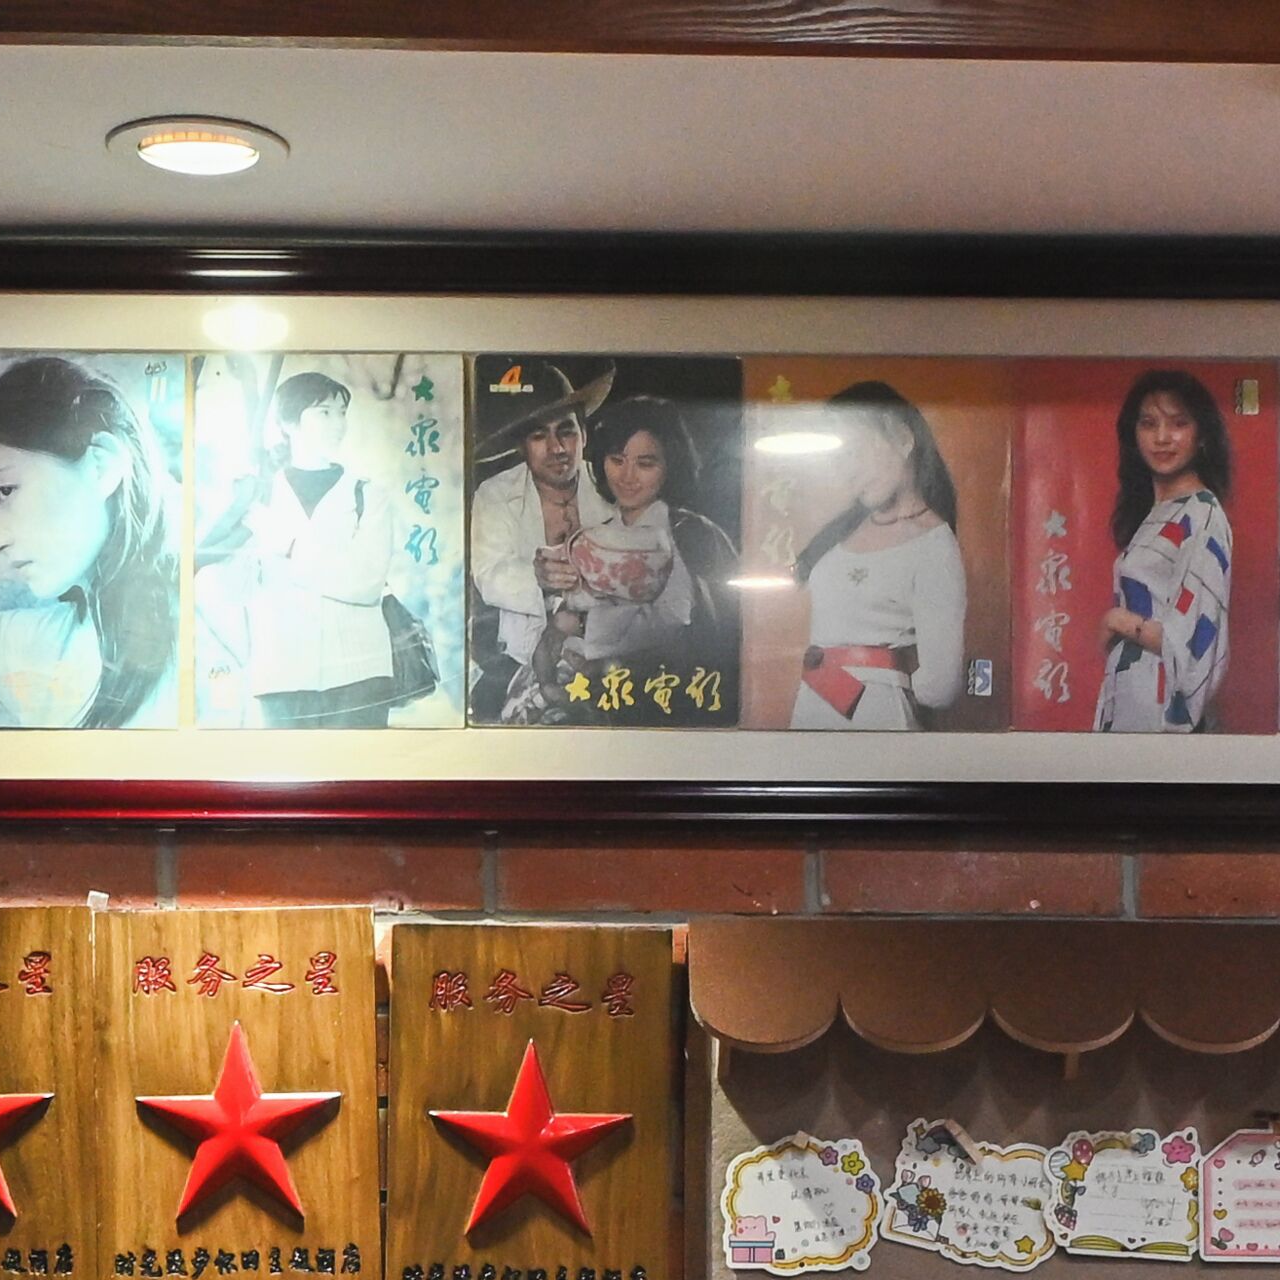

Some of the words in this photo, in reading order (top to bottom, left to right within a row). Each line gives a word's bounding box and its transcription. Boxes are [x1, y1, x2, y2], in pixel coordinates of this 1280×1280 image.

[131, 949, 342, 999] 服务之星
[427, 968, 639, 1018] 服务之星
